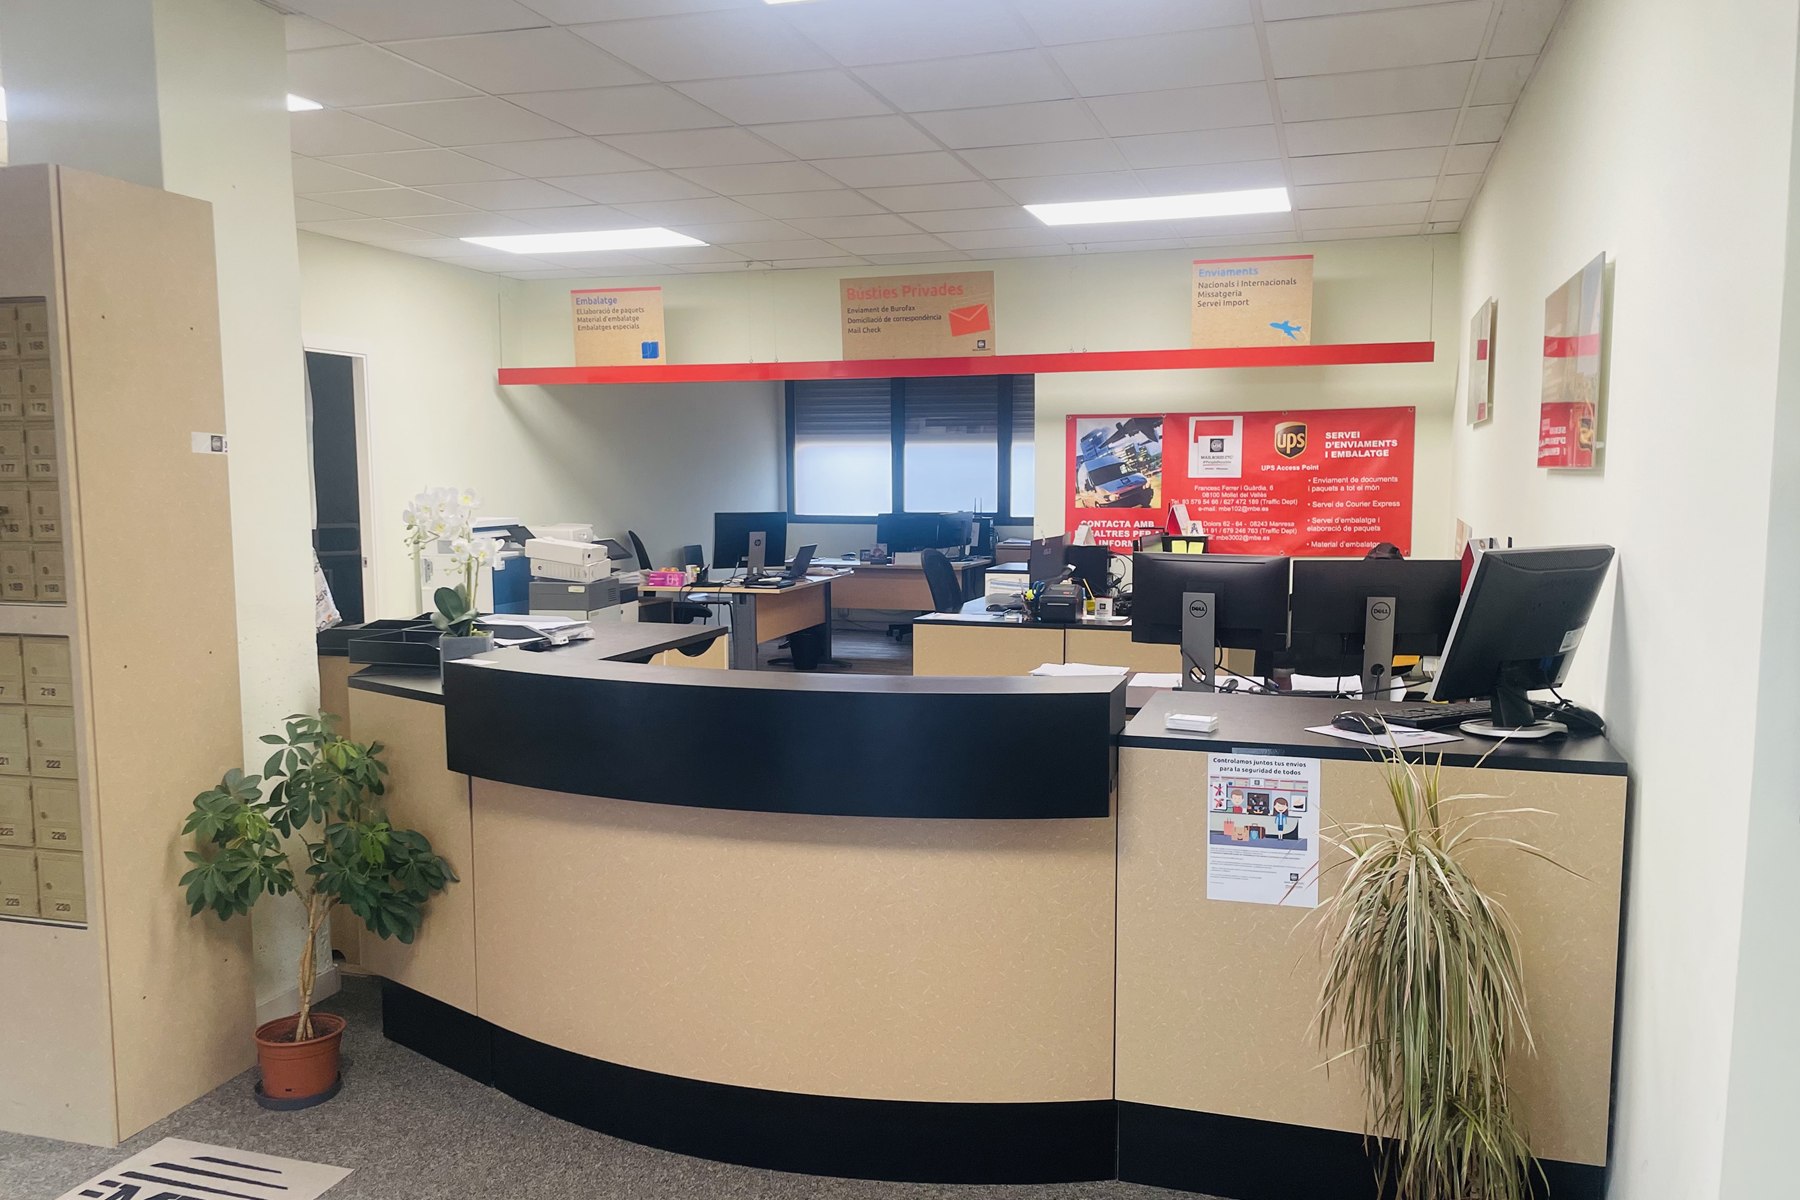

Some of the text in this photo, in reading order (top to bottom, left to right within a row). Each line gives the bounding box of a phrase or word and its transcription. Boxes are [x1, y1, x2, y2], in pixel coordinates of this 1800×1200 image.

[1199, 267, 1258, 277] Enviaments
[1241, 278, 1296, 287] Internacionals
[846, 283, 964, 301] Bústies Privades
[1198, 290, 1242, 298] Missatgeria
[576, 296, 617, 305] Embalatge
[1223, 299, 1249, 308] Import
[847, 305, 879, 314] Enviament
[32, 402, 46, 412] 172
[1325, 431, 1360, 440] SERVEI
[1277, 432, 1305, 454] ups
[1325, 439, 1398, 449] D'ENVIAMENTS
[1331, 450, 1389, 458] EMBALATGE
[1, 463, 15, 472] 177
[46, 760, 61, 768] 222
[56, 903, 71, 912] 230
